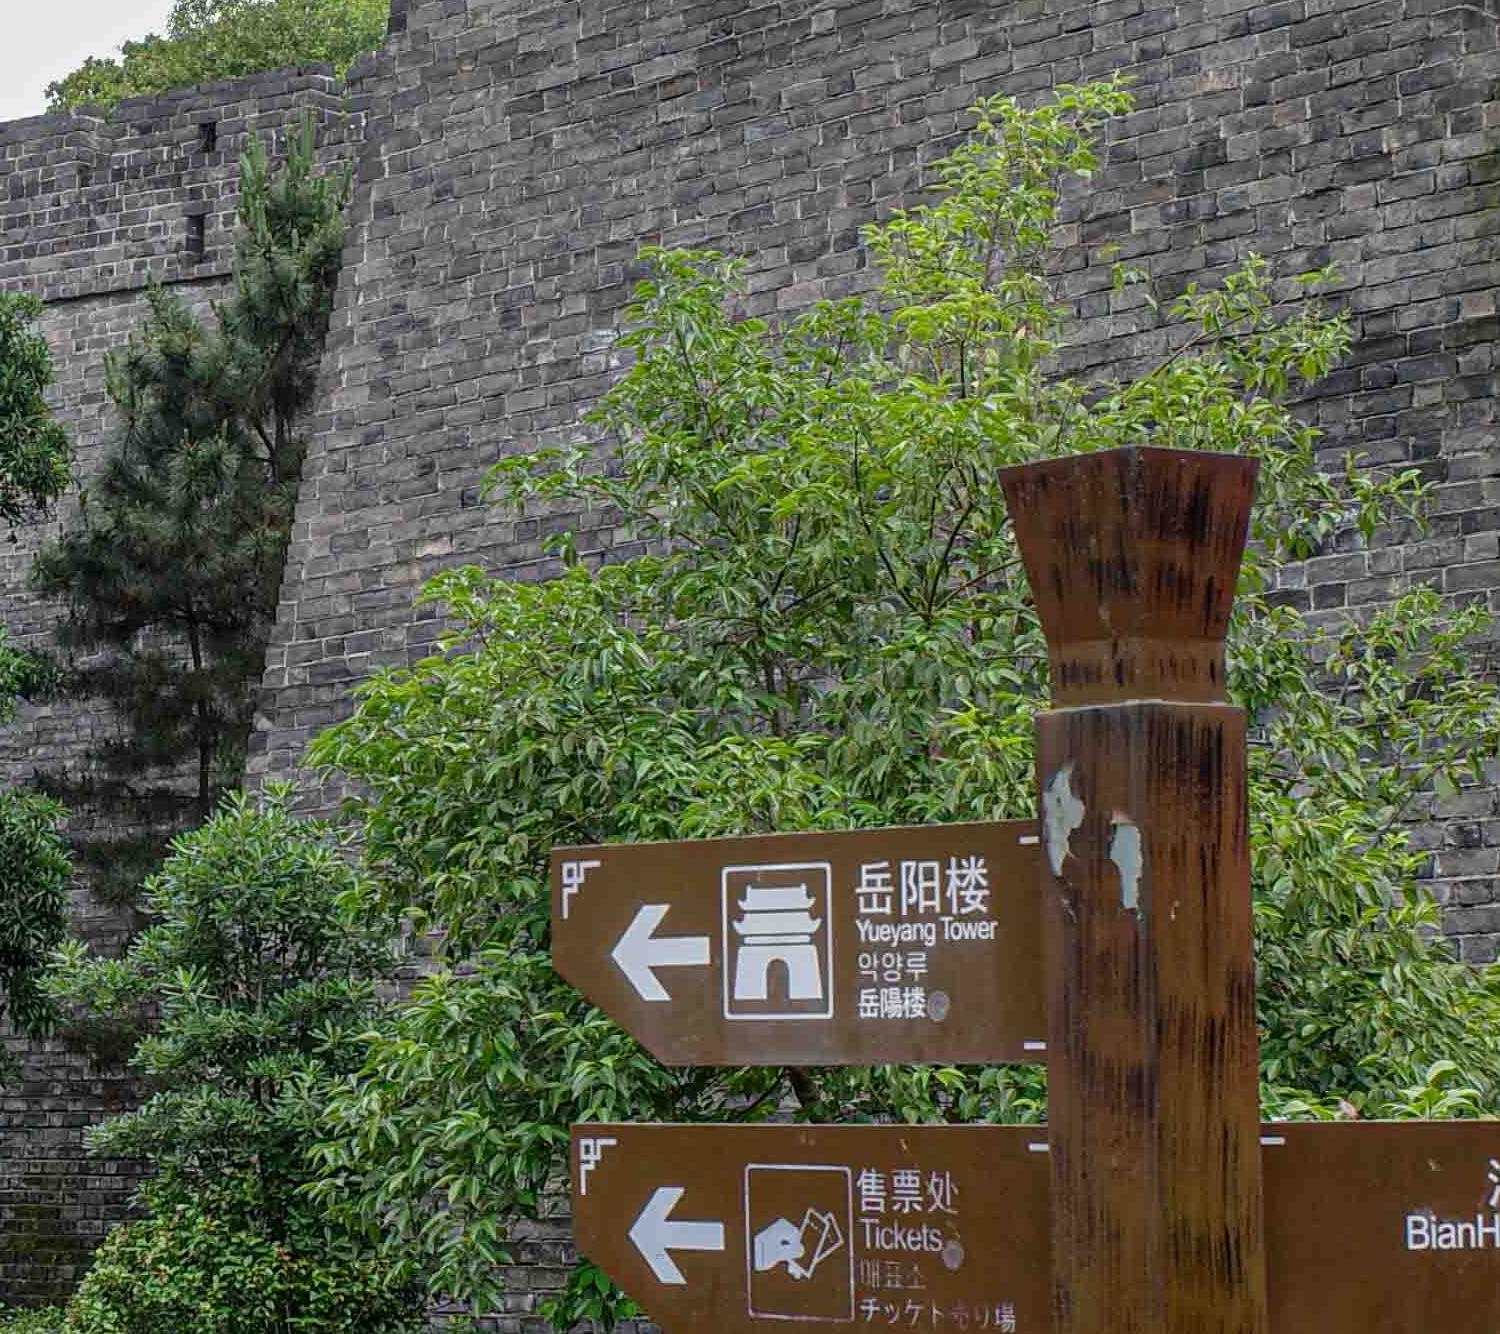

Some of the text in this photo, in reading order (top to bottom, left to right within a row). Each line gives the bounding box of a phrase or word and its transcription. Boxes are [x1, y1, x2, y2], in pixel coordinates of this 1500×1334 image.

[855, 855, 990, 916] 岳阳楼
[855, 916, 998, 947] Yueyang Tower
[858, 952, 928, 982] 악양루
[857, 987, 926, 1019] 岳陽楼
[856, 1167, 959, 1214] 售票处
[858, 1218, 944, 1251] Tickets
